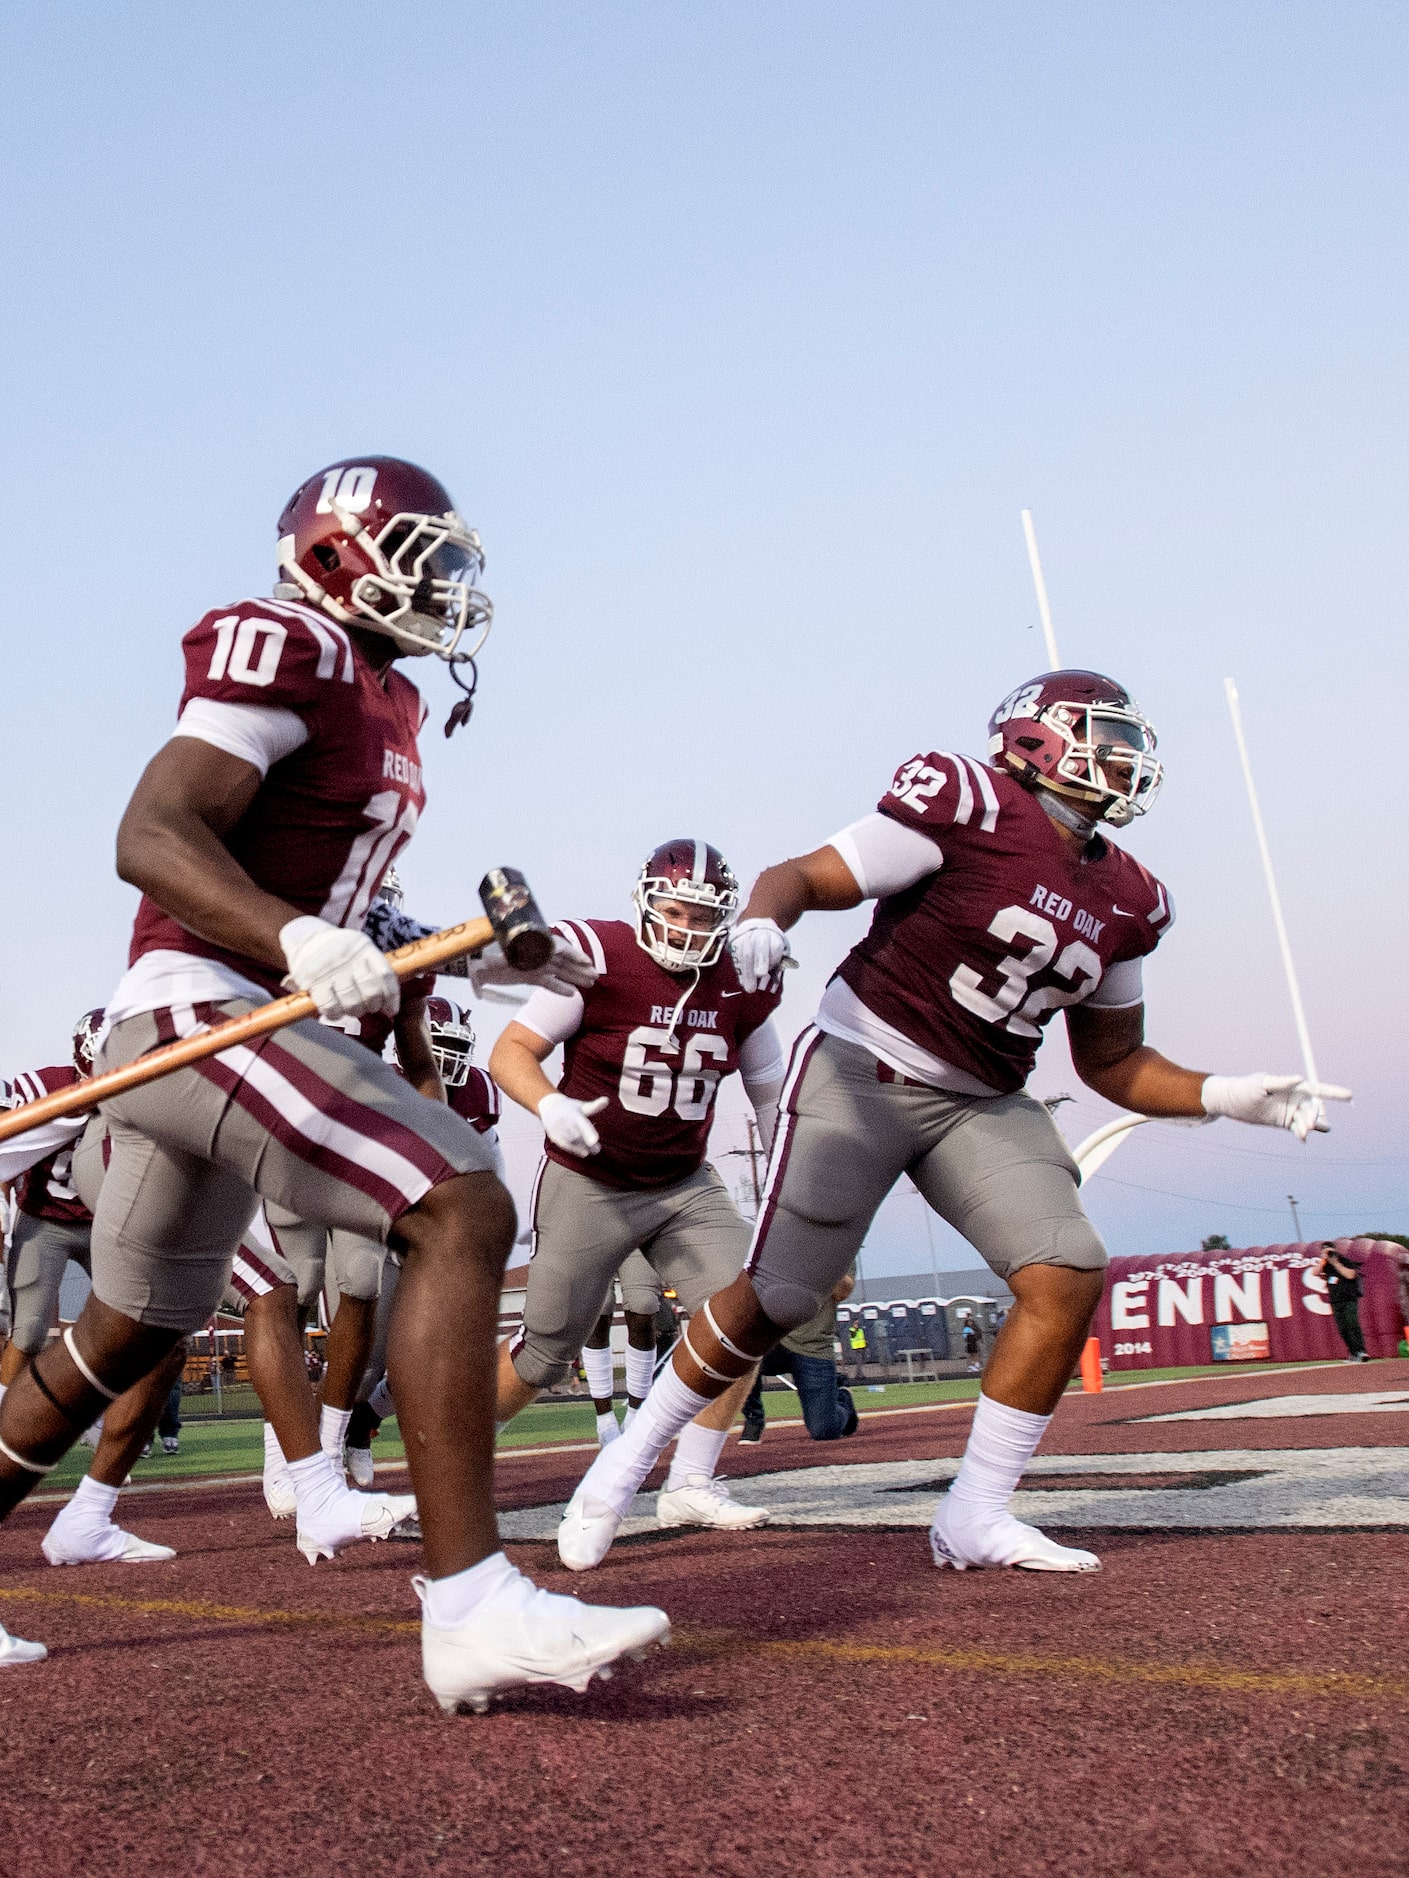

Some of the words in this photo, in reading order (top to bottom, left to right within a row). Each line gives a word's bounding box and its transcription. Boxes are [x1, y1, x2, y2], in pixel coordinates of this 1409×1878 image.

[316, 466, 378, 514] 10
[207, 615, 288, 687] 10
[994, 684, 1045, 724] 32
[383, 749, 409, 784] RED
[892, 760, 947, 814] 32
[1029, 884, 1073, 921] RED
[1073, 908, 1106, 944] OAK
[948, 905, 1103, 1038] 32
[650, 1005, 683, 1025] RED
[688, 1009, 718, 1029] OAK
[618, 1025, 729, 1121] 66
[1111, 1266, 1334, 1330] ENNIS
[1113, 1341, 1153, 1356] 2014
